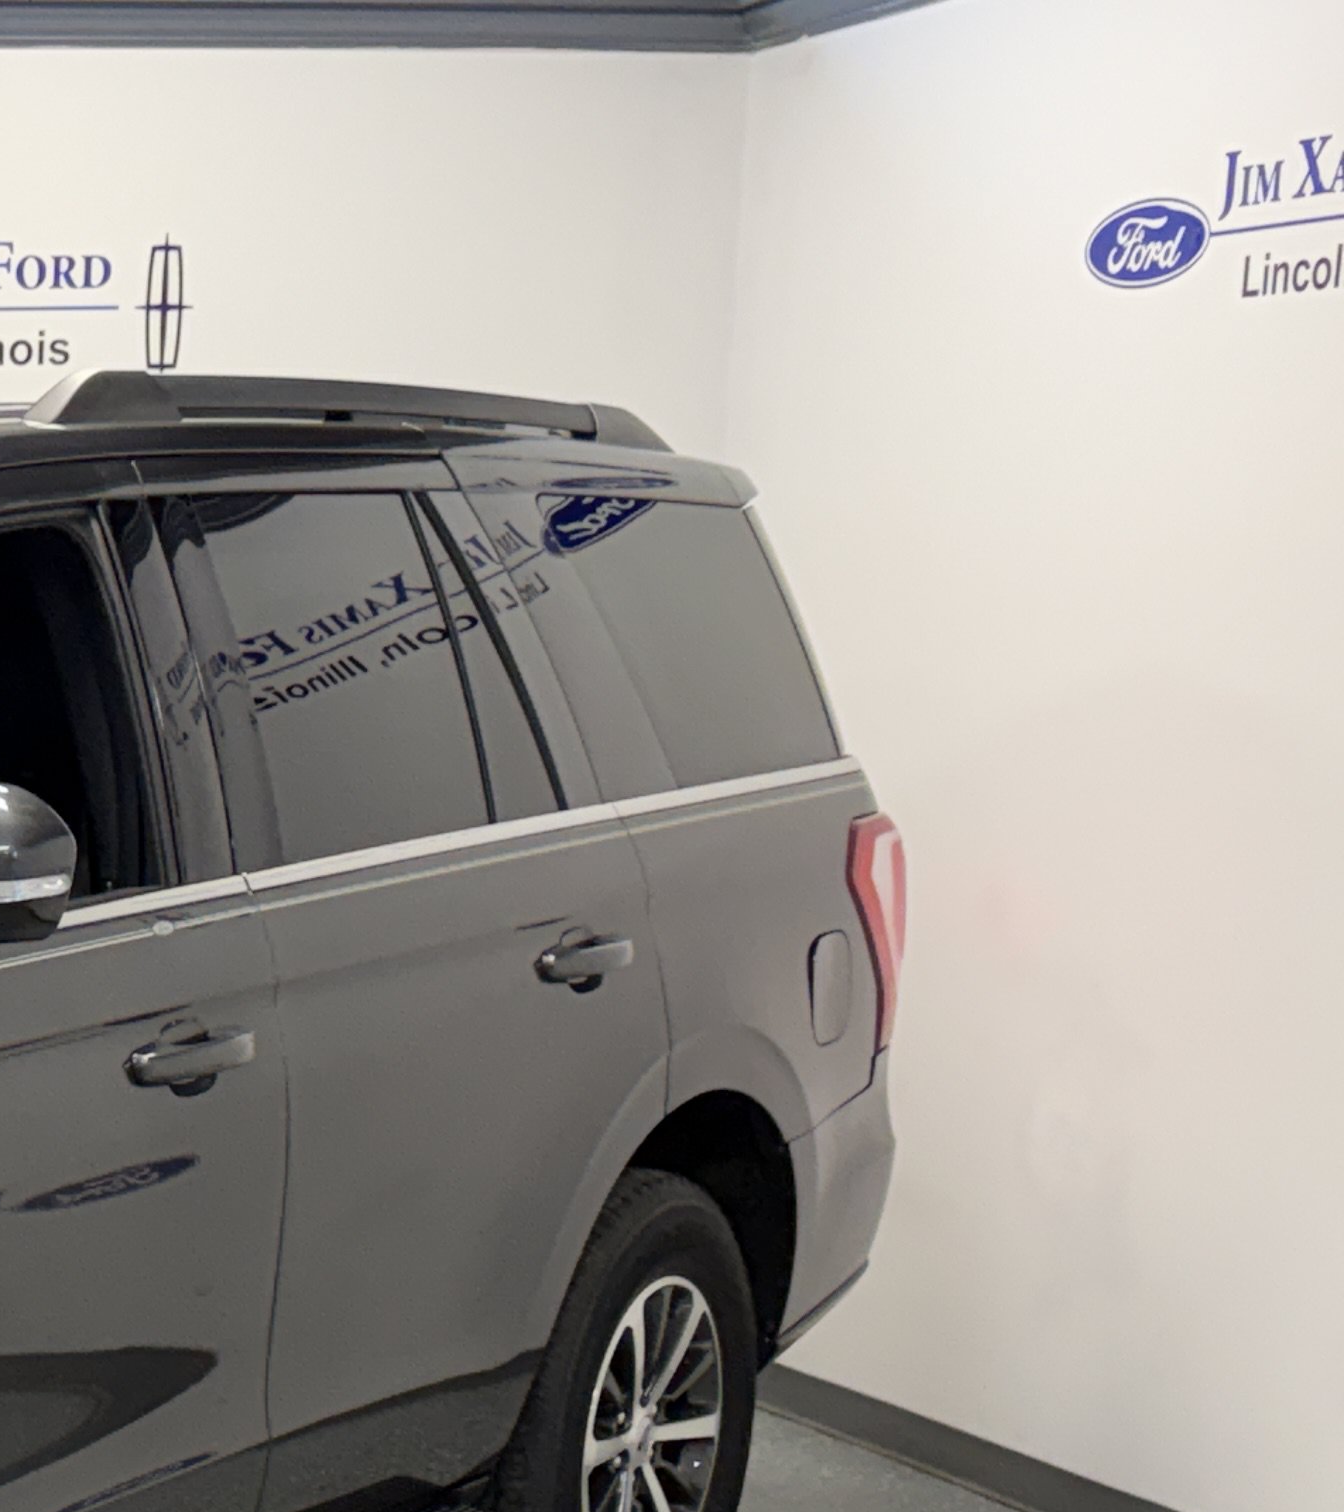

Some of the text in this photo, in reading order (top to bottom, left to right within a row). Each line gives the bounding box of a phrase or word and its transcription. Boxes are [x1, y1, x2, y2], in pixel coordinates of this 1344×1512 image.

[1218, 150, 1285, 221] JIM
[1107, 215, 1187, 275] Ford
[1241, 243, 1344, 298] Lincol
